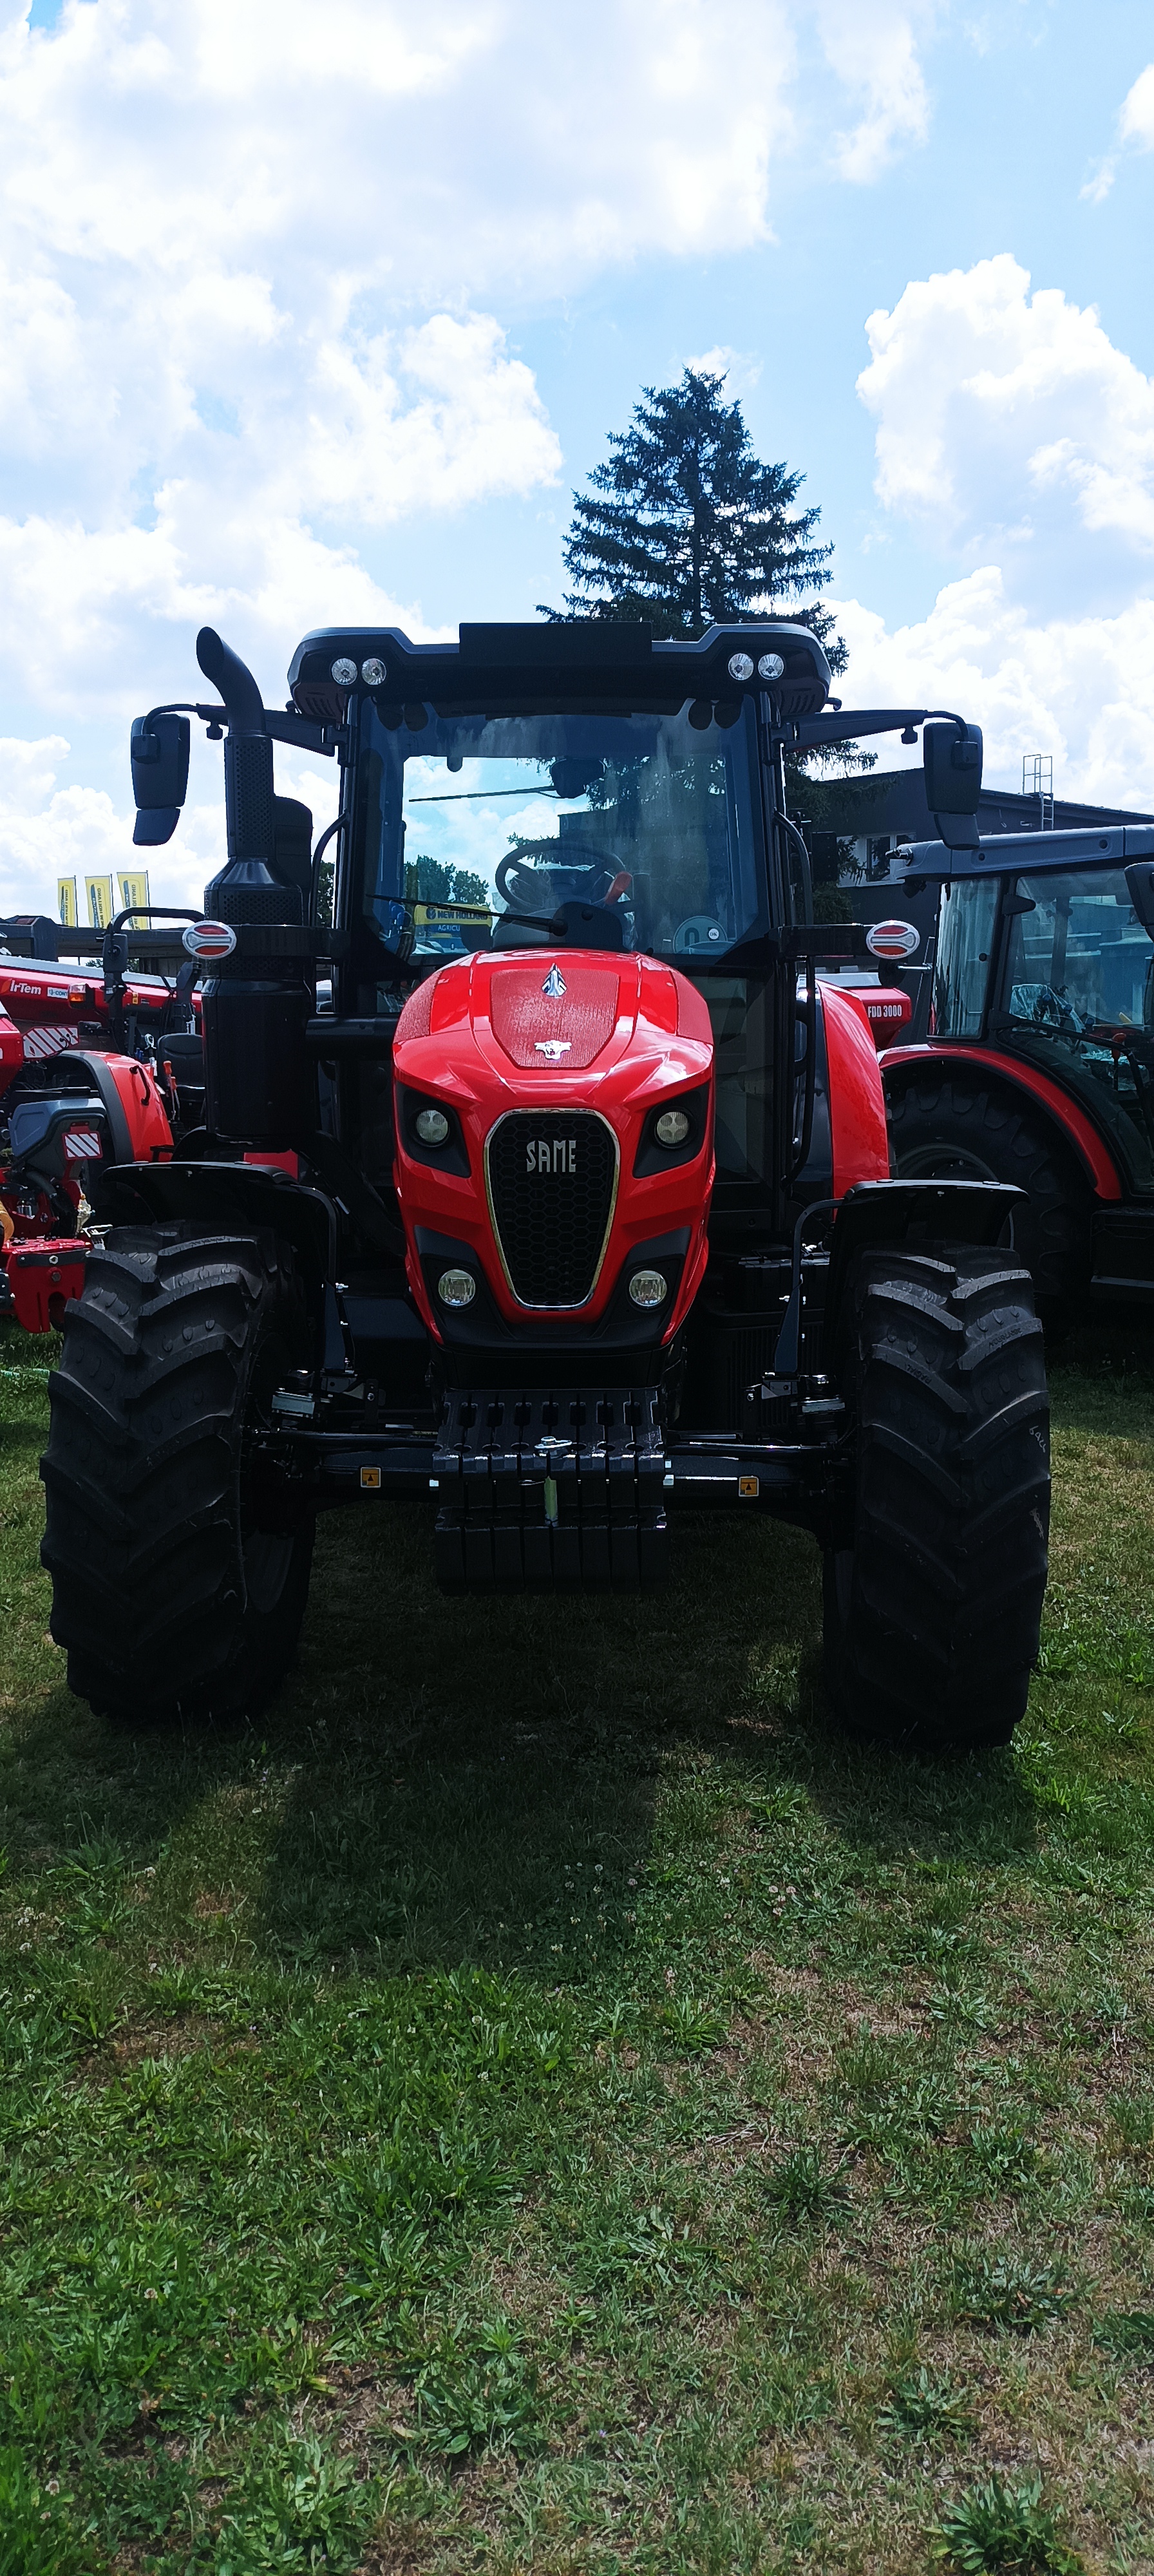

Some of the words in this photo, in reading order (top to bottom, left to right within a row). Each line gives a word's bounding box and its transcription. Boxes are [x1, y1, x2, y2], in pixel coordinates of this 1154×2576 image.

[438, 911, 455, 919] NEW
[867, 1006, 882, 1018] FDD
[884, 1005, 902, 1016] 3000
[526, 1140, 576, 1172] SAME
